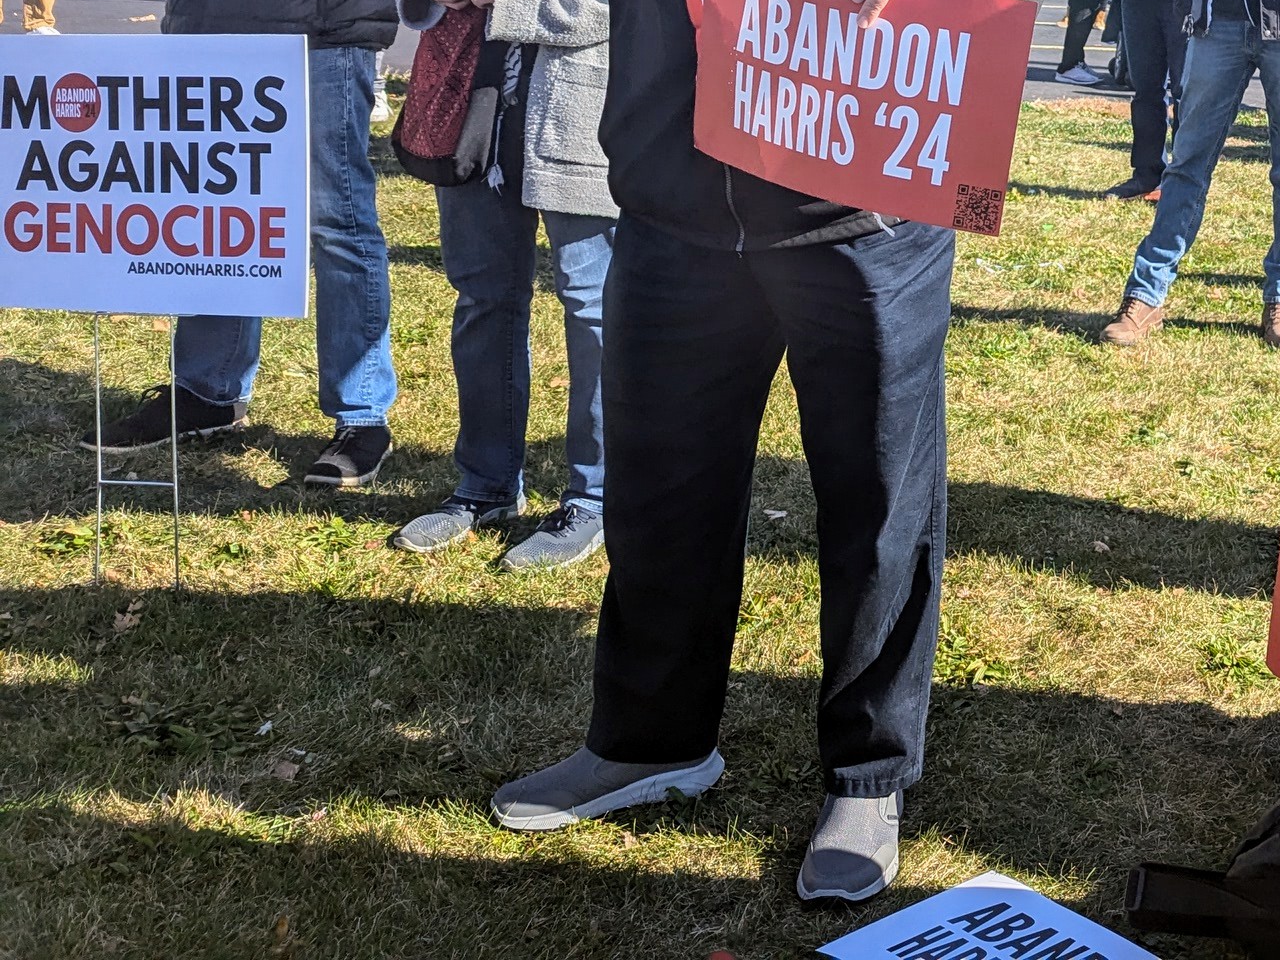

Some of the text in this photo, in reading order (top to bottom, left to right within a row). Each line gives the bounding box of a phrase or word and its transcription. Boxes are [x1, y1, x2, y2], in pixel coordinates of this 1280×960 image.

[55, 88, 96, 103] ABANDON
[55, 103, 81, 118] HARRIS
[733, 60, 860, 166] HARRIS
[16, 140, 272, 194] AGAINST
[4, 201, 286, 259] GENOCIDE
[127, 262, 282, 278] ABANDONHARRIS.COM
[946, 902, 1112, 960] ABAN
